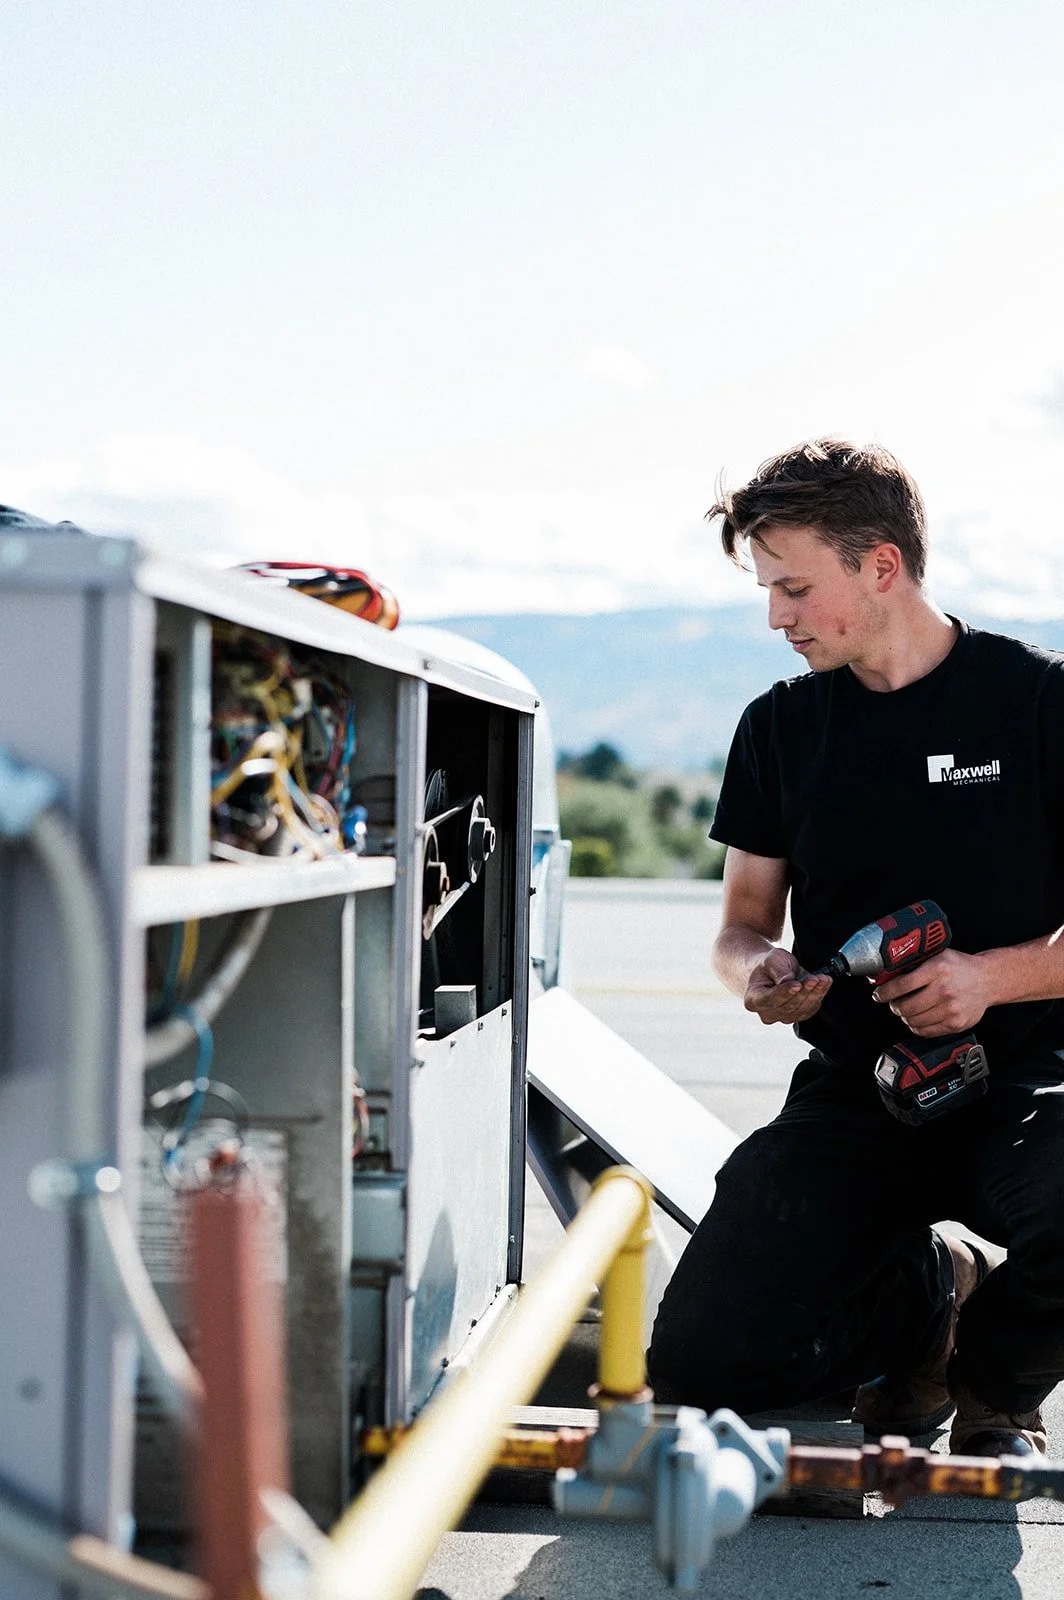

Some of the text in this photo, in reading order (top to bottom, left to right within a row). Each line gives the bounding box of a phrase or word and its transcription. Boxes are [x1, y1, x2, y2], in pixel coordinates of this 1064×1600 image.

[941, 760, 1000, 781] Maxwell
[953, 776, 1000, 785] MECHANICAL
[919, 1088, 936, 1100] M18
